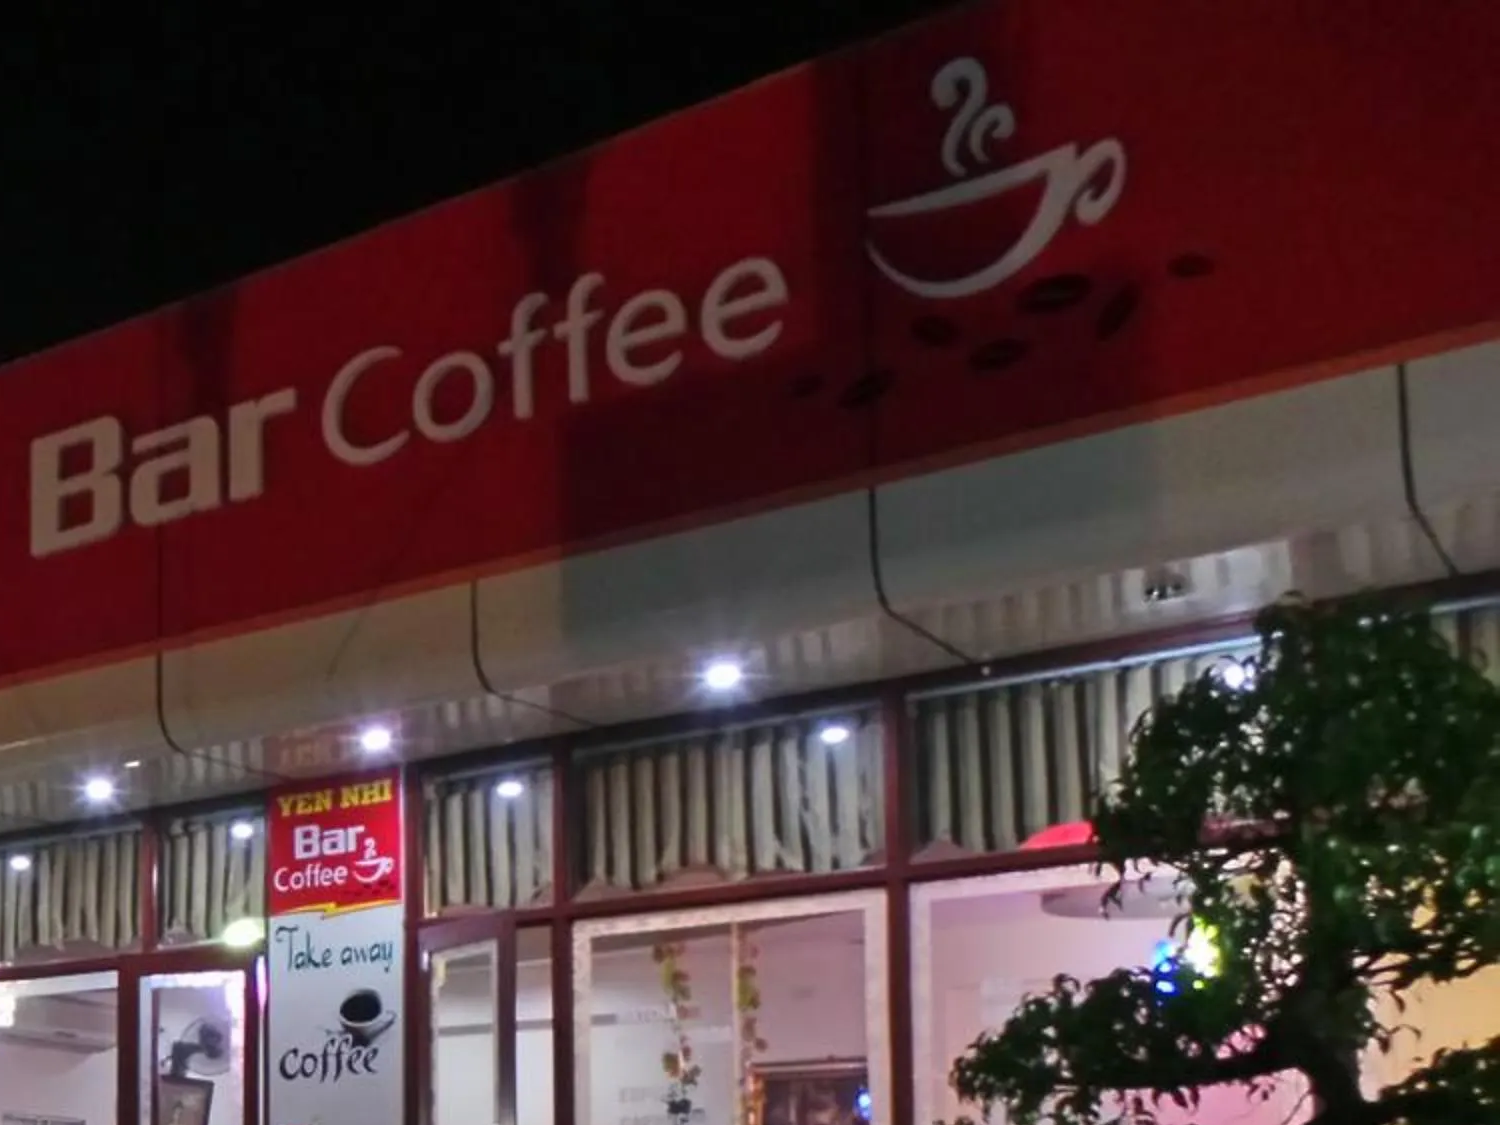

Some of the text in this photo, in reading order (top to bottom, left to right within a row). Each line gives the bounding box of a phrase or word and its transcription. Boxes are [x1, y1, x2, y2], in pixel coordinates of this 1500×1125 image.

[29, 387, 297, 560] Bar
[321, 256, 790, 467] Coffee
[277, 778, 393, 817] YEN NHI
[293, 822, 365, 860] Bar
[273, 862, 348, 892] Coffee
[275, 925, 393, 973] Take away
